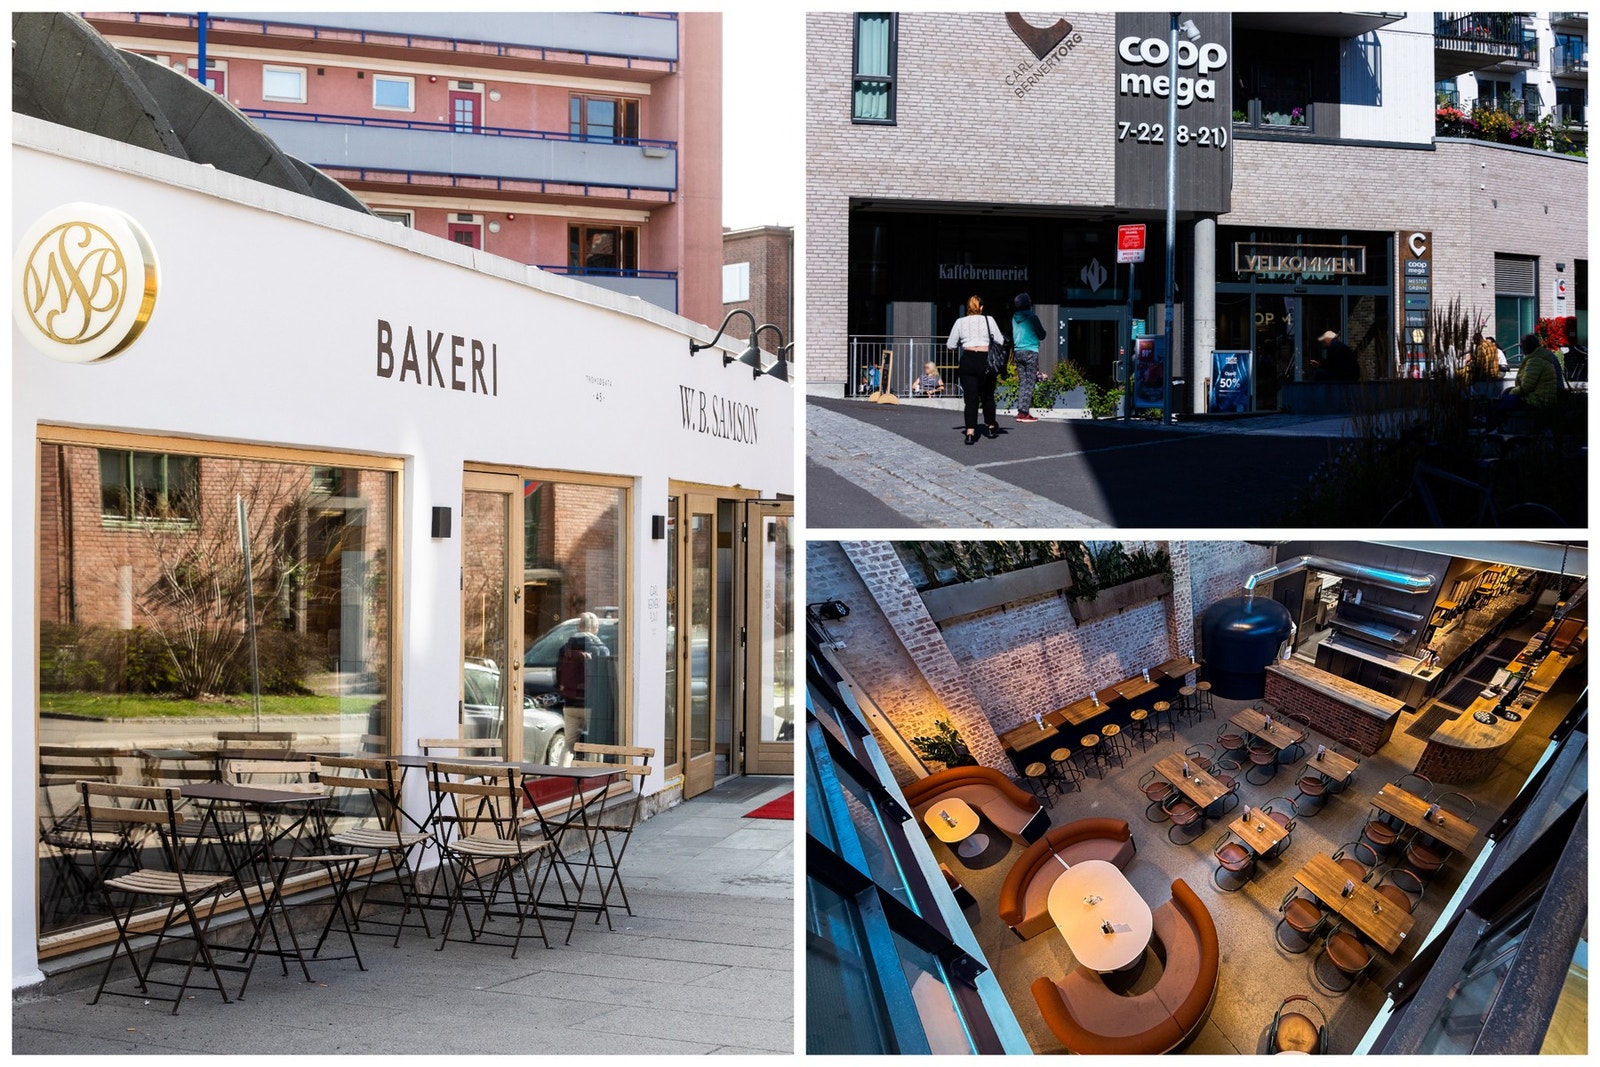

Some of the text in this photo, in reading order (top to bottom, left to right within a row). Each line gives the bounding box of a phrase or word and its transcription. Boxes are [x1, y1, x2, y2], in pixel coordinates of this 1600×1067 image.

[1119, 36, 1228, 74] coop
[1005, 60, 1033, 86] CARL
[1120, 73, 1216, 106] mega
[1118, 121, 1228, 149] 7-22 8-21)
[939, 263, 1029, 281] Kaffebrenneriet
[1245, 254, 1356, 273] VELKOMMEN
[1408, 261, 1427, 269] coop
[376, 318, 498, 397] BAKERI
[1219, 378, 1241, 388] 50%
[712, 394, 759, 446] SAMSON
